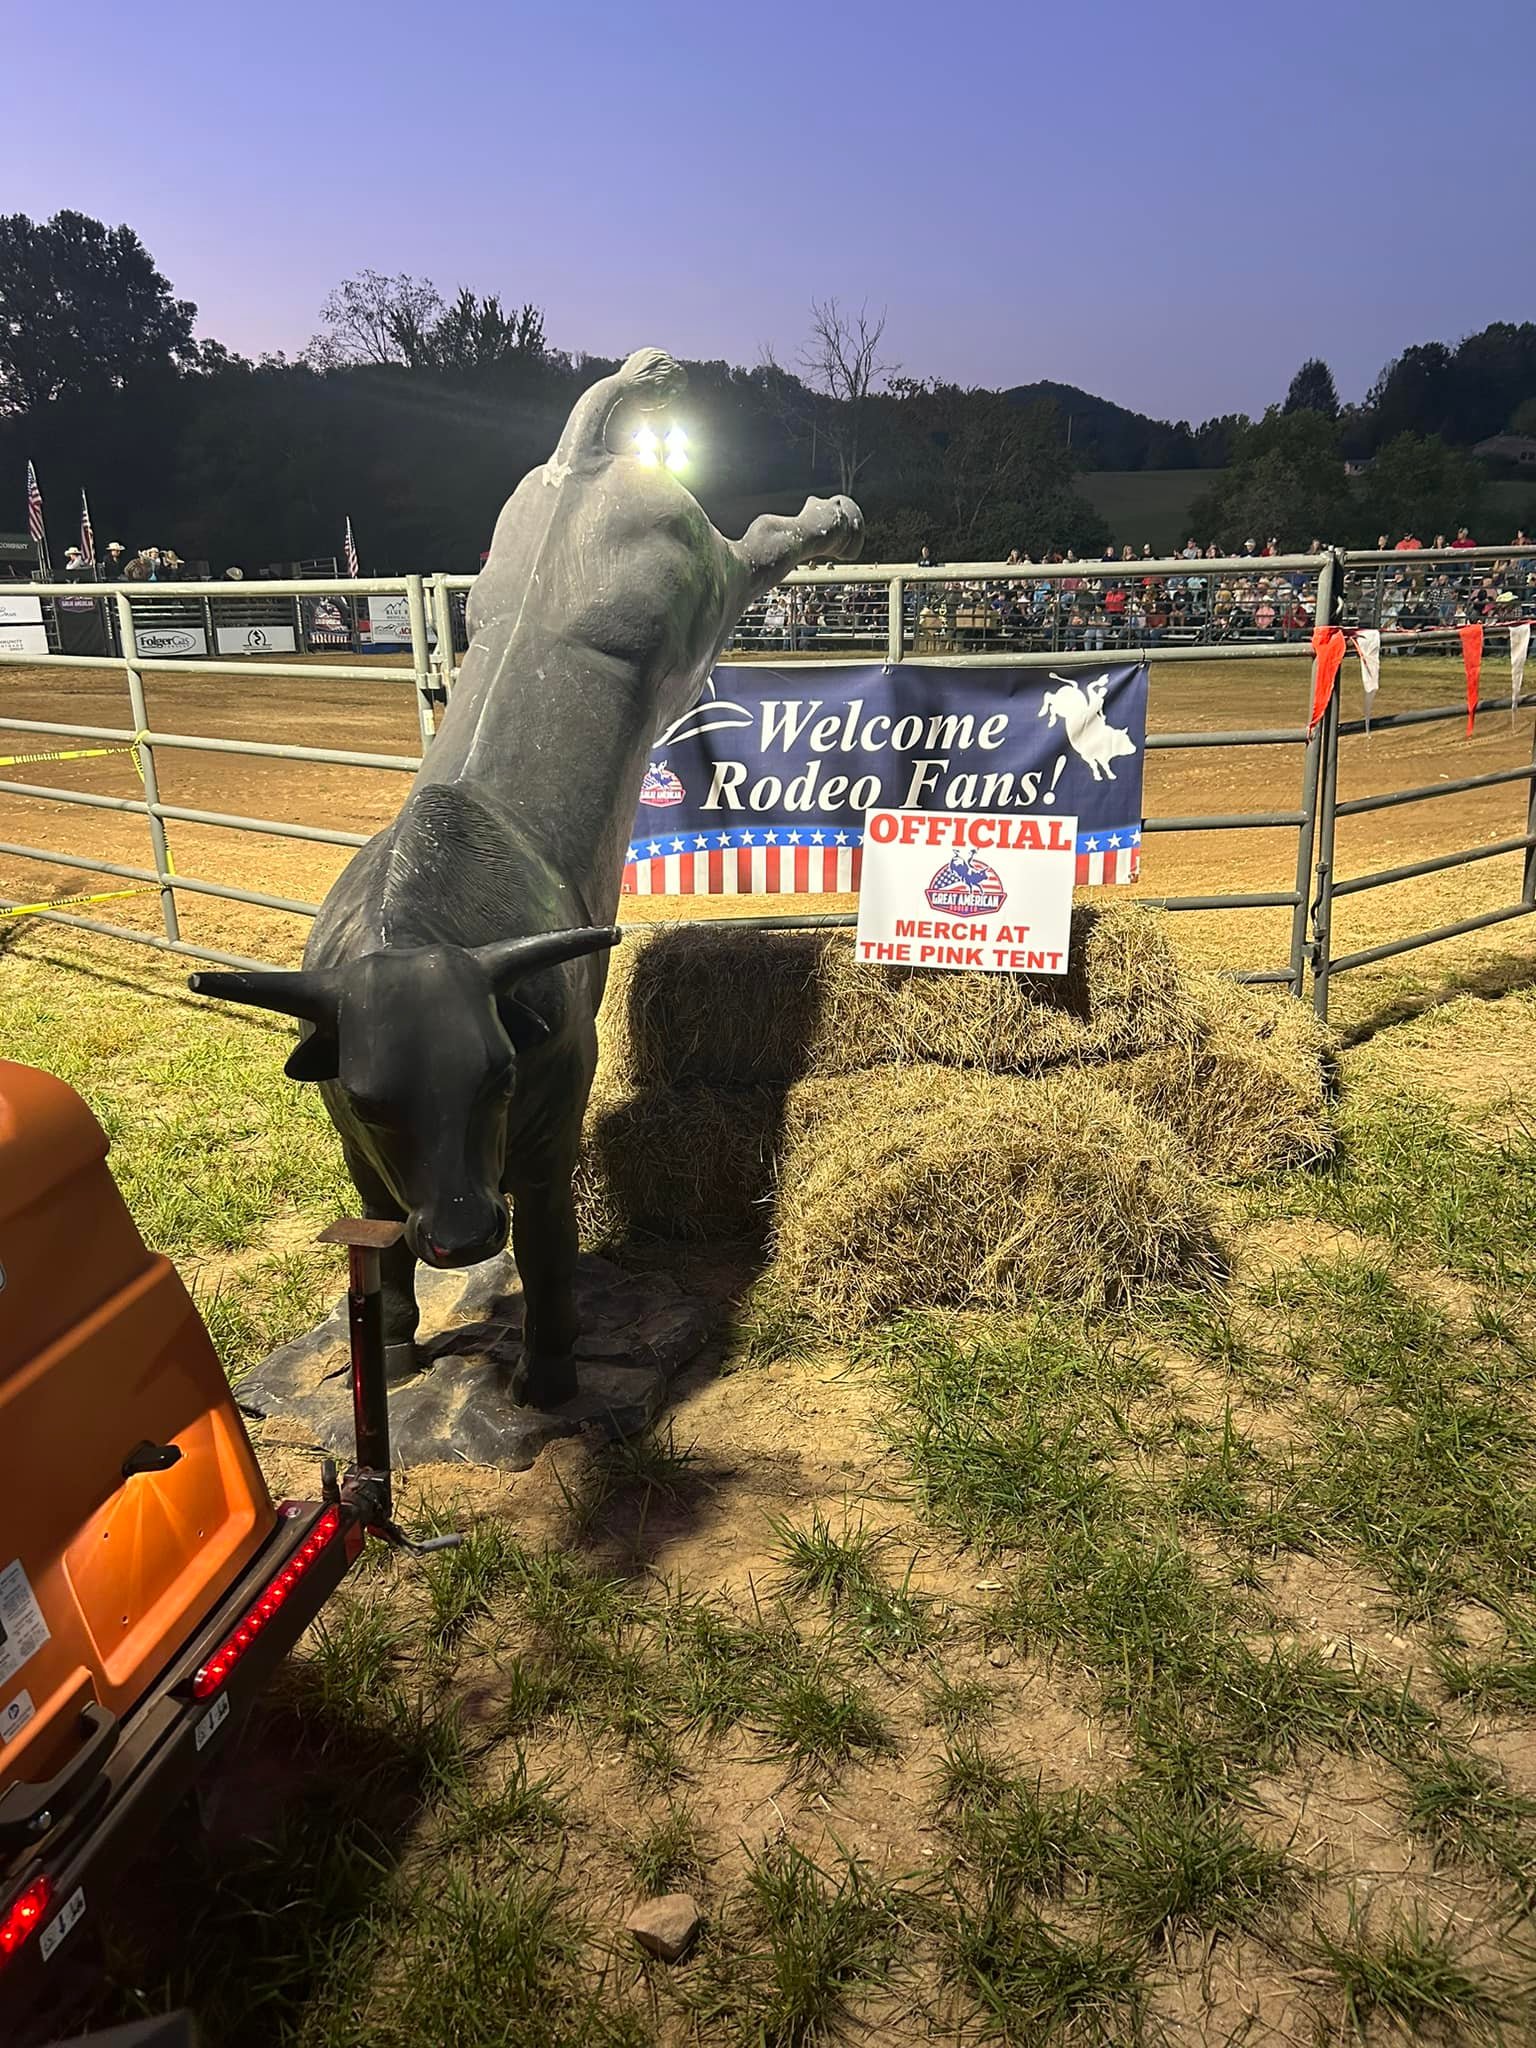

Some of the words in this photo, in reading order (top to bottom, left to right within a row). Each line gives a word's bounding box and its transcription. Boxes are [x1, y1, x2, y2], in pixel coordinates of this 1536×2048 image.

[759, 699, 1009, 753] Welcome
[699, 759, 883, 811] Rodeo
[898, 754, 1067, 810] Fans!
[869, 813, 1072, 851] OFFICIAL
[932, 892, 957, 905] GREAT
[957, 894, 999, 907] AMERICAN
[895, 919, 987, 942] MERCH
[995, 926, 1030, 943] AT
[860, 942, 911, 961] THE
[920, 946, 985, 966] PINK
[993, 949, 1063, 970] TENT
